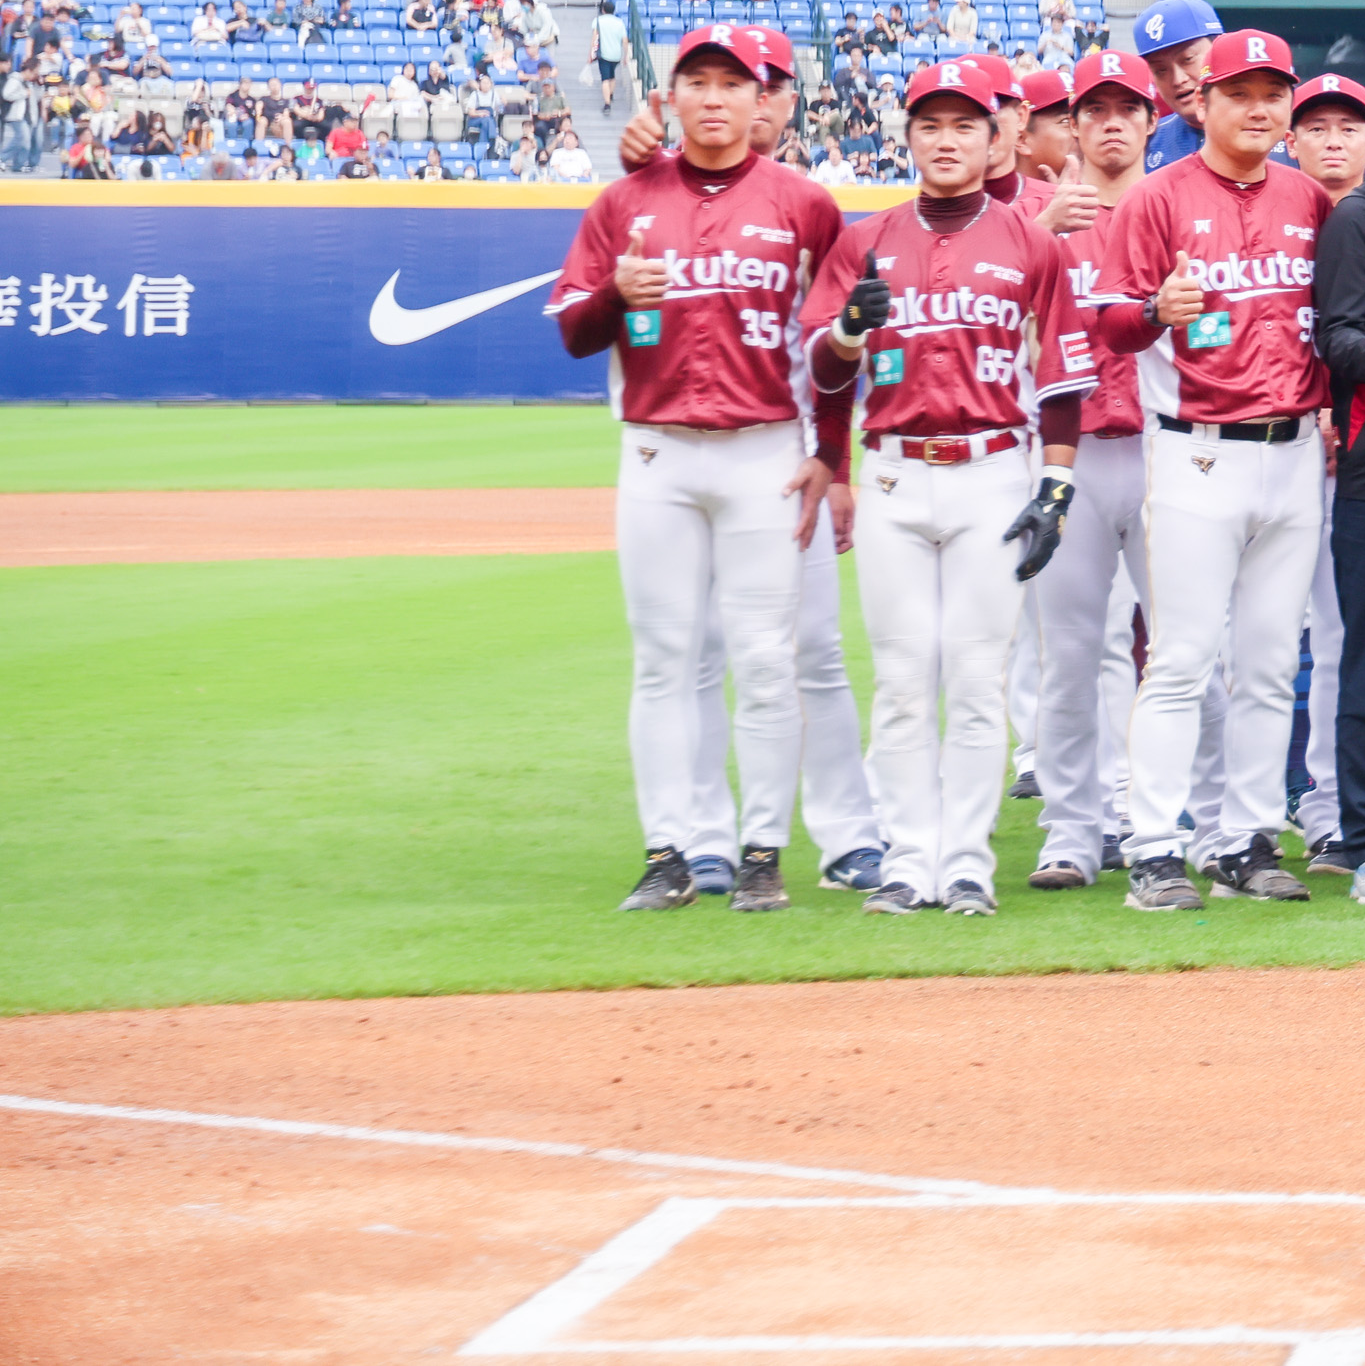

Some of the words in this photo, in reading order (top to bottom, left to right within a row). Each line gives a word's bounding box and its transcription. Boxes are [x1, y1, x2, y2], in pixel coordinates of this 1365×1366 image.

[710, 24, 735, 47] R
[1246, 36, 1272, 62] R
[938, 64, 966, 86] R
[1101, 53, 1126, 76] R
[1322, 76, 1340, 92] R
[1187, 251, 1316, 292] Rakute
[0, 273, 195, 336] 投信
[886, 286, 1021, 331] akuten
[740, 309, 783, 349] 35
[1297, 306, 1317, 343] 9
[976, 345, 1015, 386] 65
